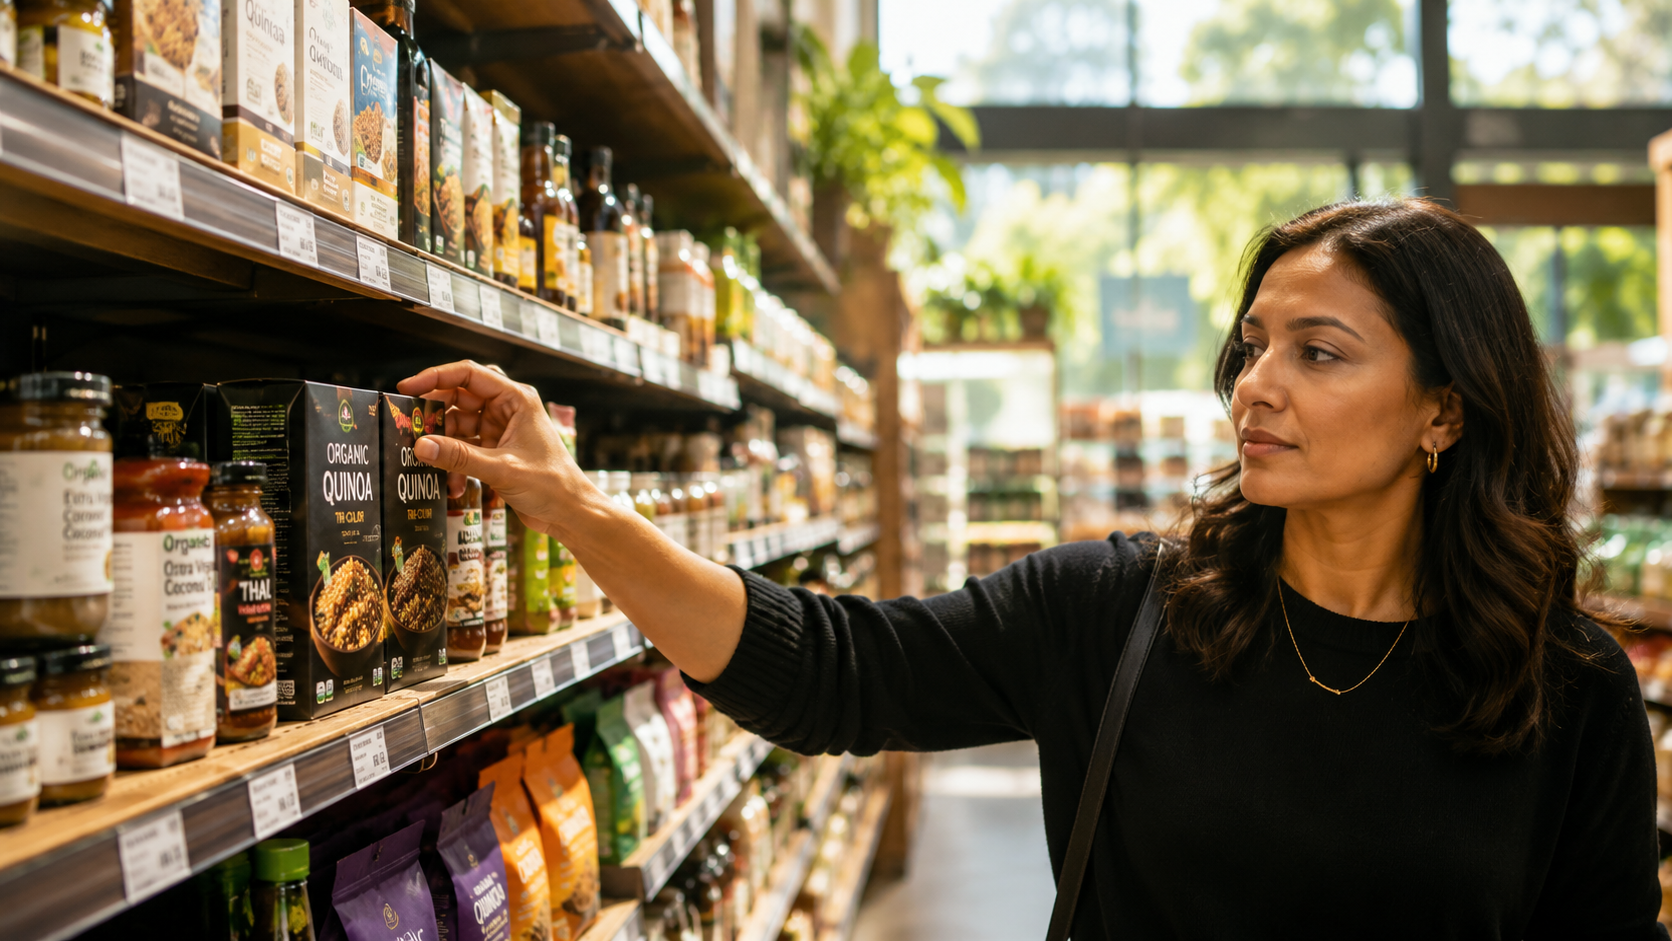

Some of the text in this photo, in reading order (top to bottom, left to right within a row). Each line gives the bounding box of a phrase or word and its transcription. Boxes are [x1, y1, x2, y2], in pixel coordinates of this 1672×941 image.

[327, 443, 369, 465] ORGANIC
[323, 471, 373, 506] QUINOA
[397, 473, 441, 503] QUINOA
